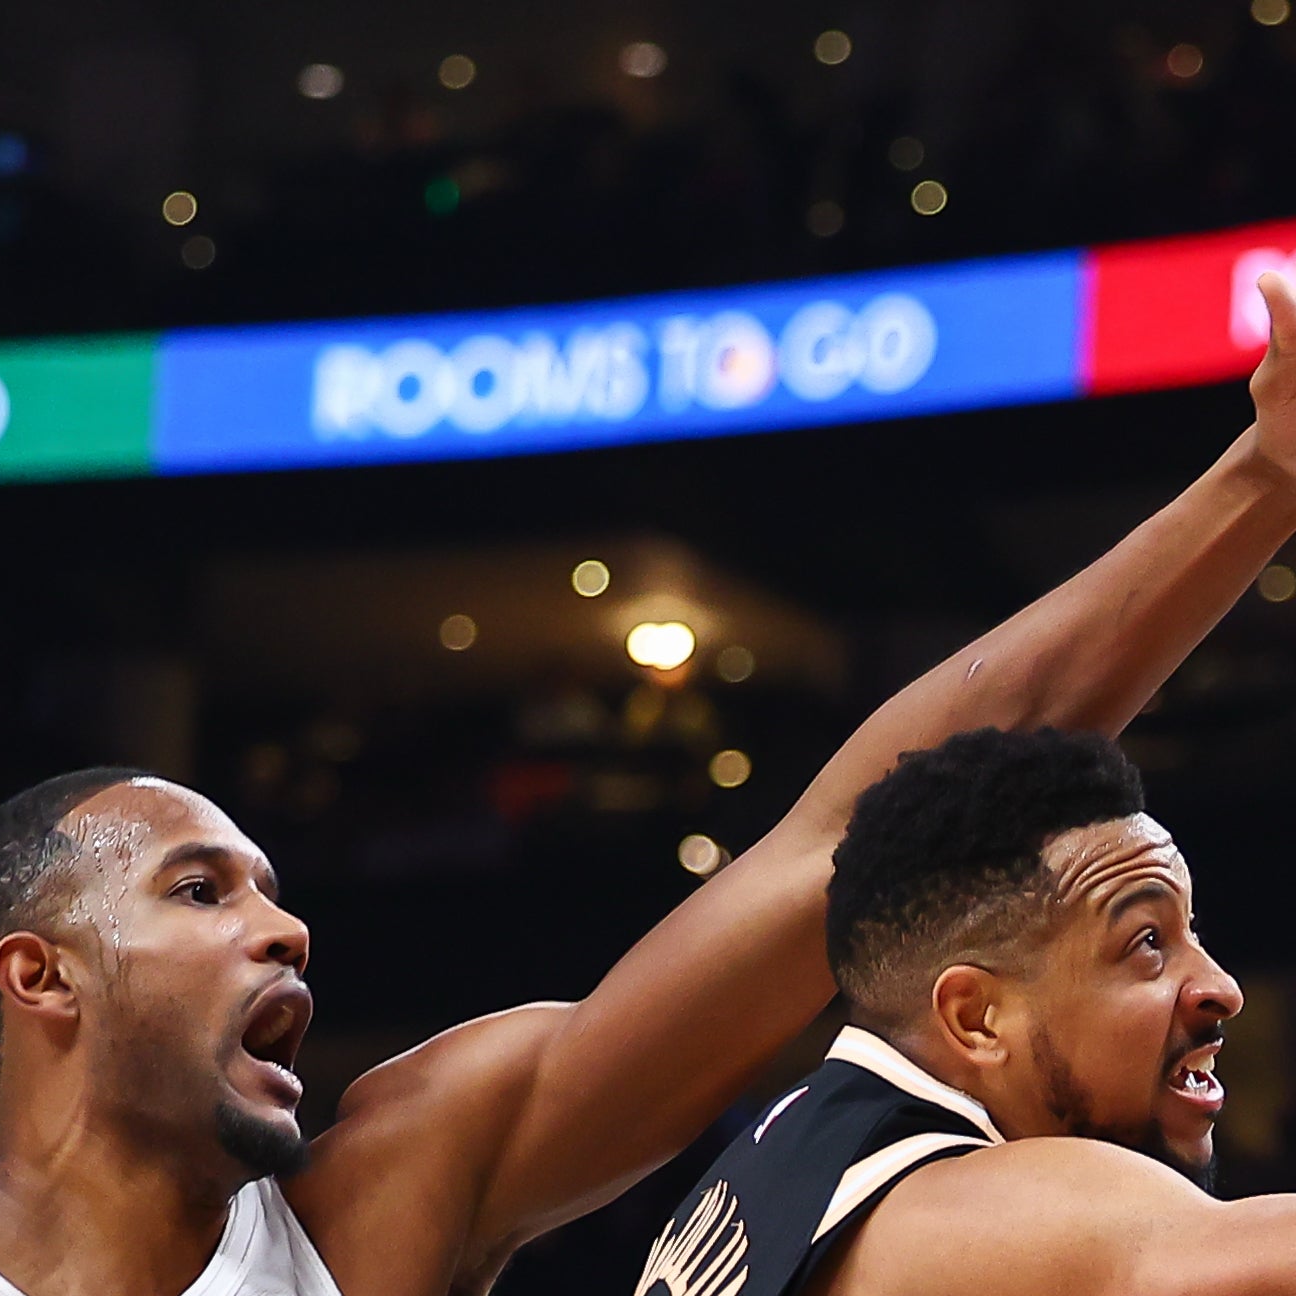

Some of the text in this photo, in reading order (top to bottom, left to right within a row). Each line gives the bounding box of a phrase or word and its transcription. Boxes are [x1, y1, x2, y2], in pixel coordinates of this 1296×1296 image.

[310, 291, 938, 443] ROOMS TO GO
